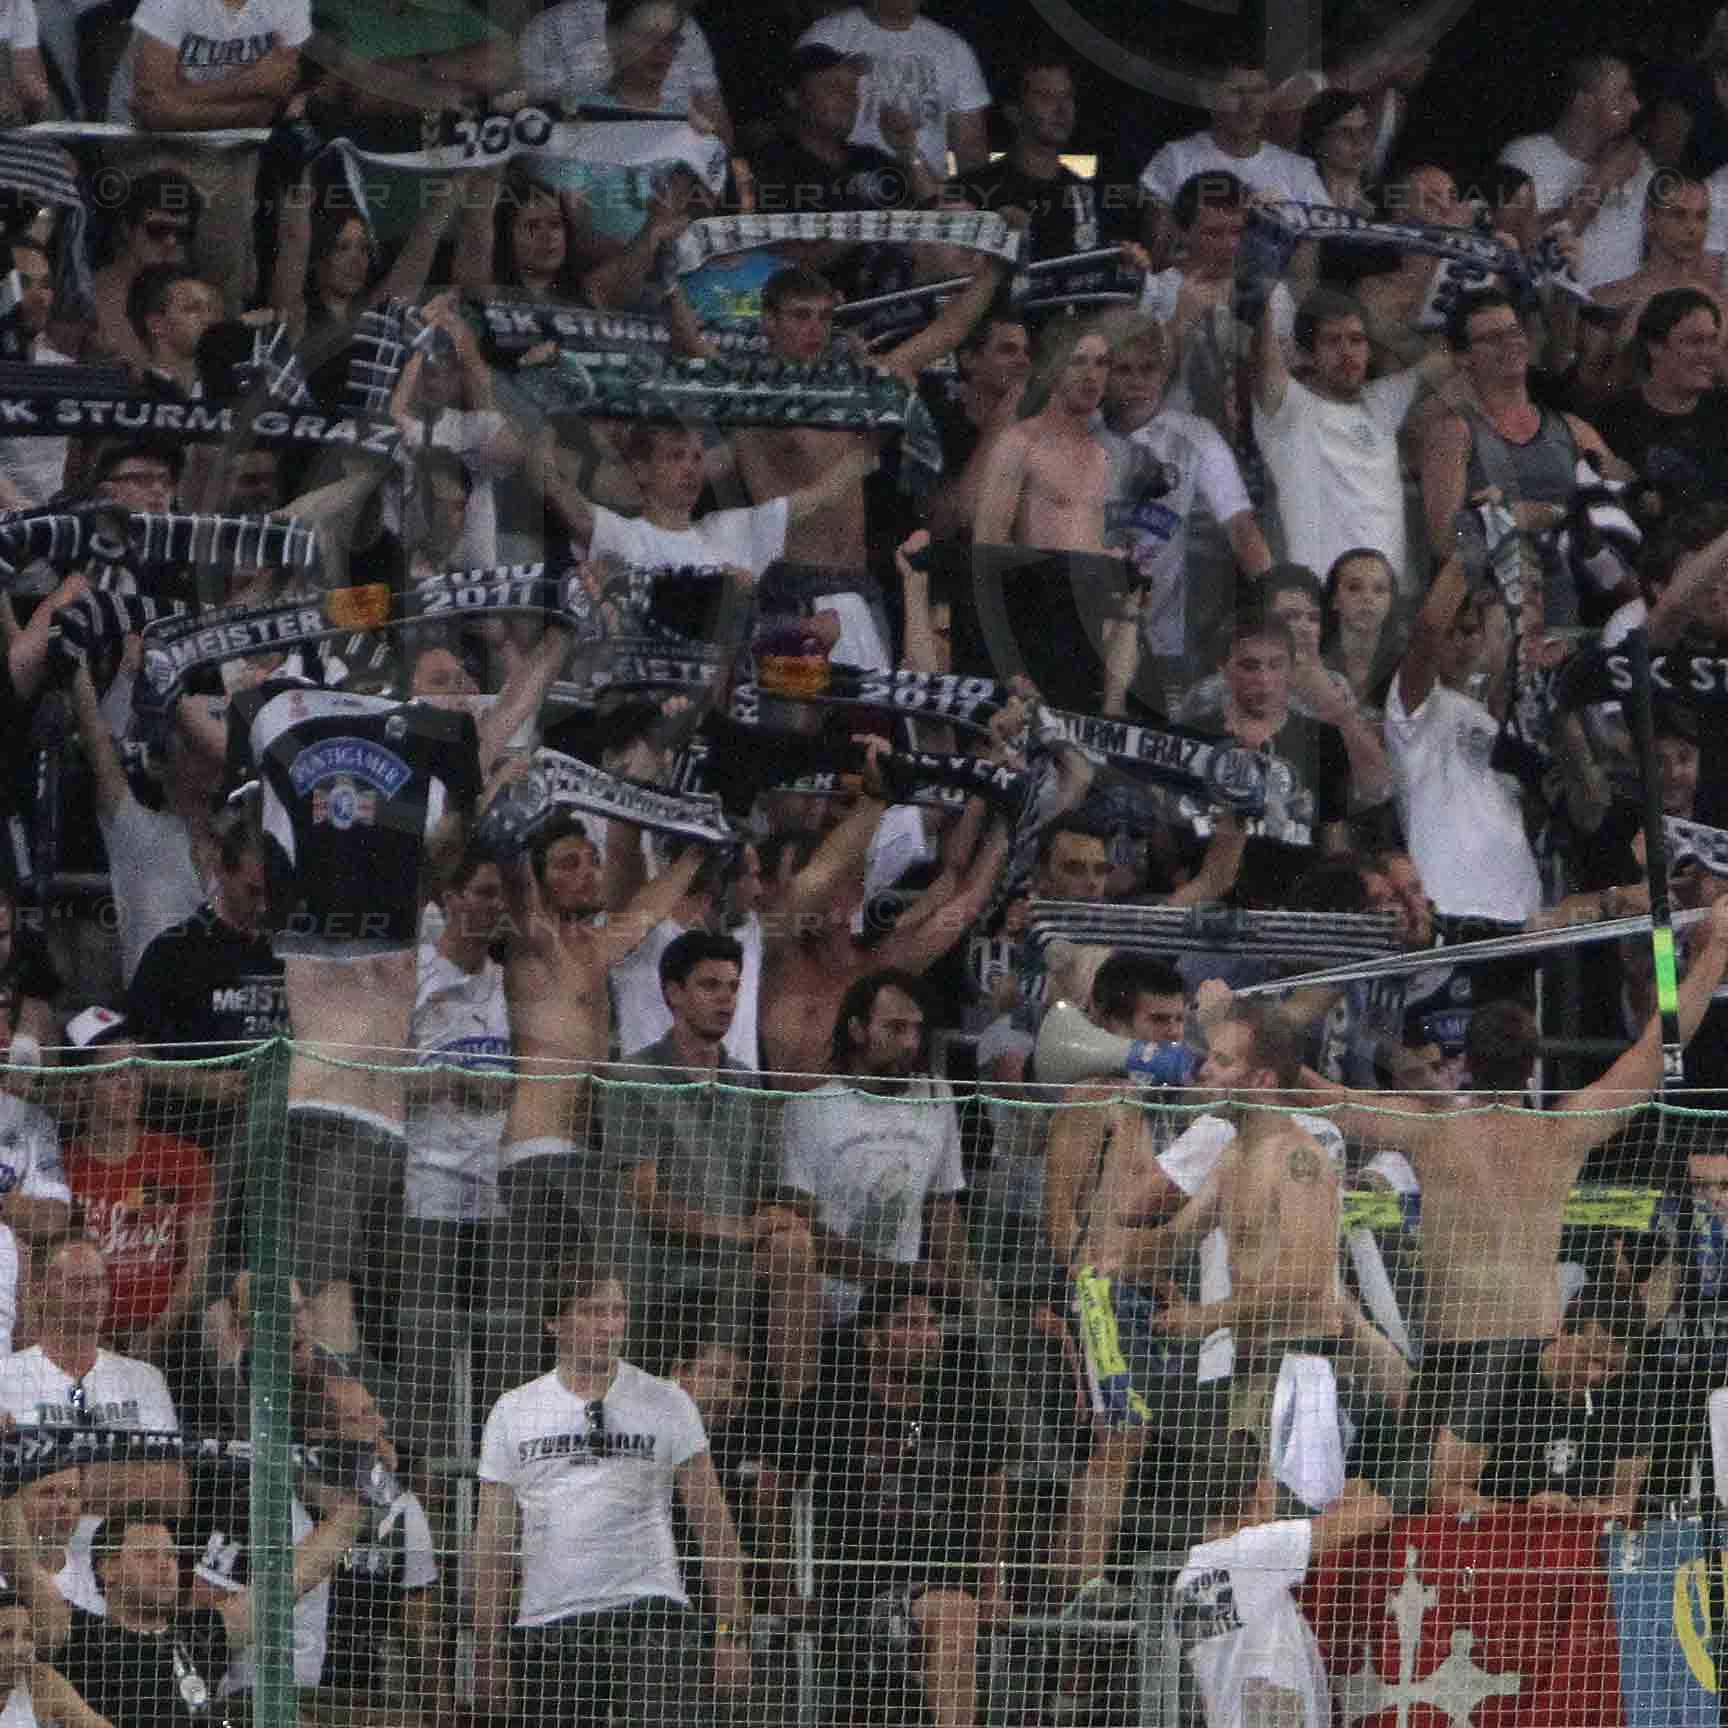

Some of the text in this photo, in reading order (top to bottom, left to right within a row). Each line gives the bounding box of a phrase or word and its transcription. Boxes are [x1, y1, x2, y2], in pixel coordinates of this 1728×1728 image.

[57, 405, 234, 436] STURM
[252, 413, 394, 455] GRAZ
[422, 586, 536, 612] 2011
[165, 608, 324, 662] MEISTER
